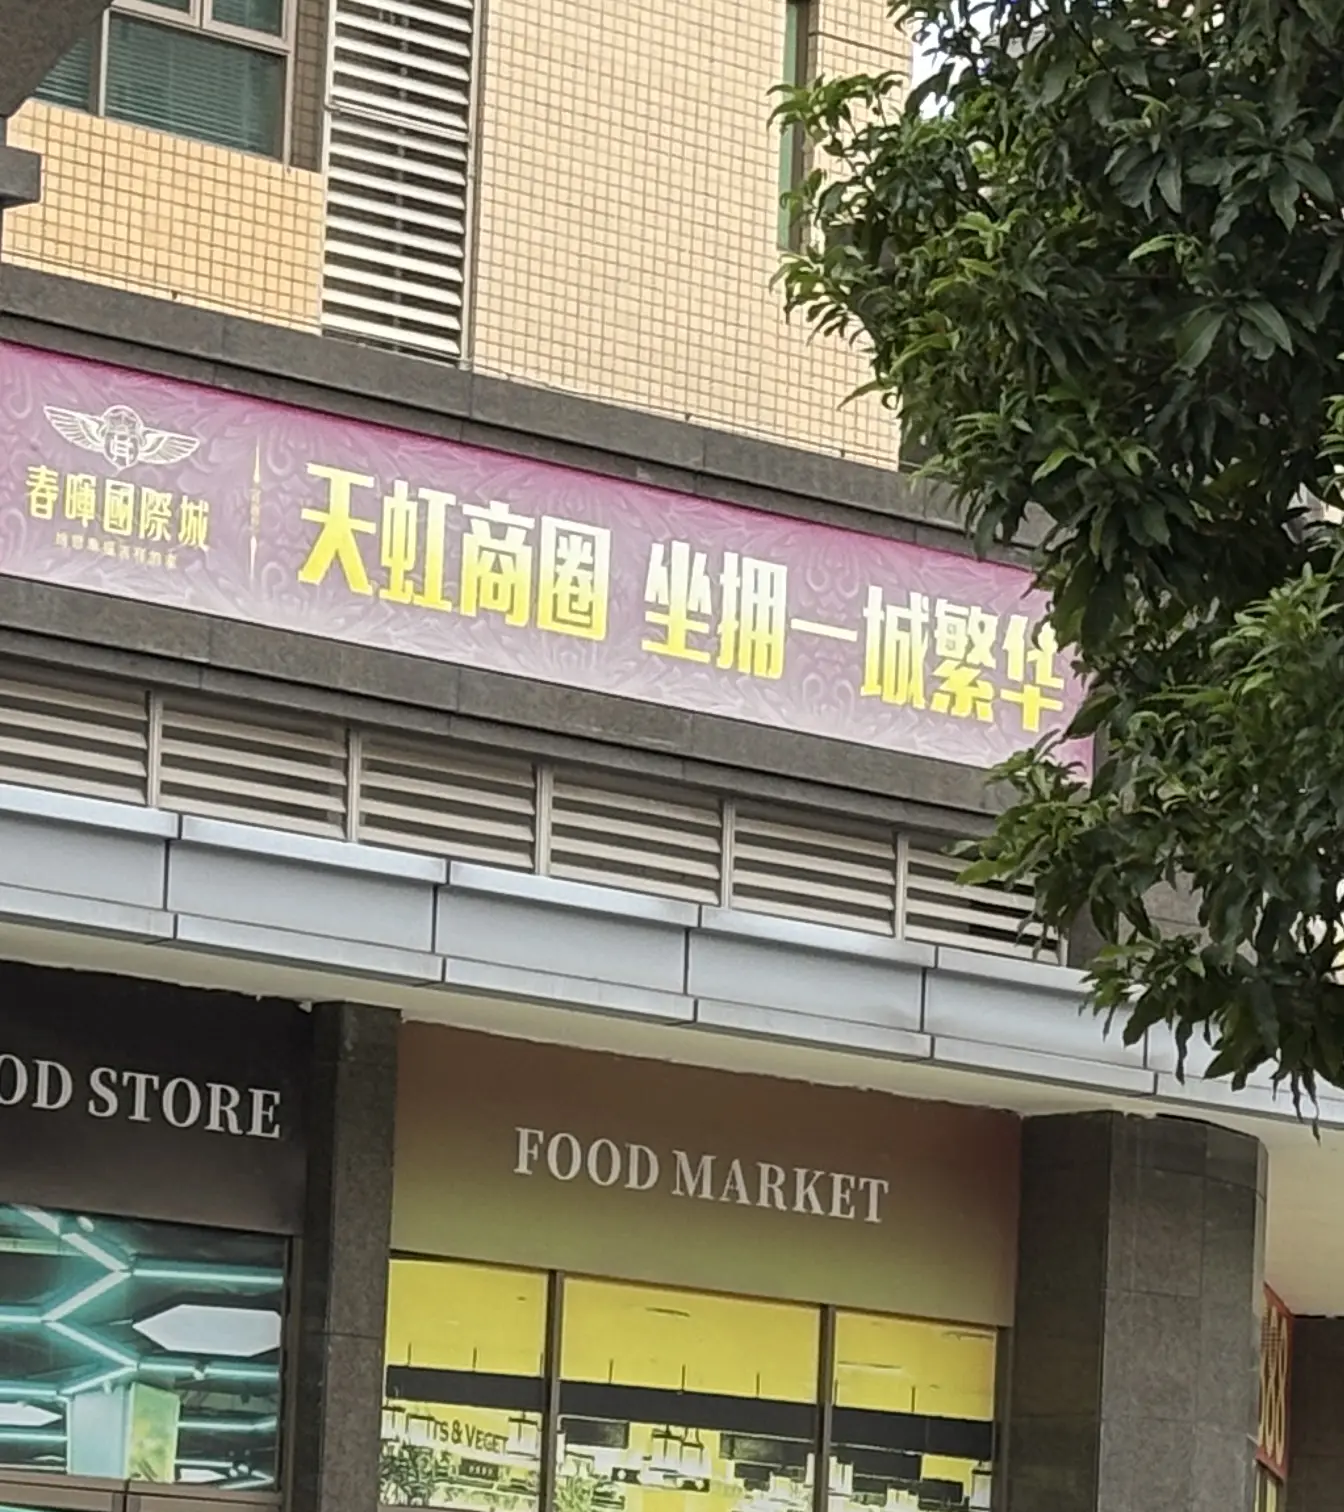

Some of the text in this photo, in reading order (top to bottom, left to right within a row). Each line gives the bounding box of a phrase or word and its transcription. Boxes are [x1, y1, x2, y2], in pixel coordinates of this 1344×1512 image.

[297, 462, 1065, 733] 天虹商圈 坐拥一城繁华
[88, 1067, 281, 1139] STORE
[513, 1127, 890, 1223] FOOD MARKET
